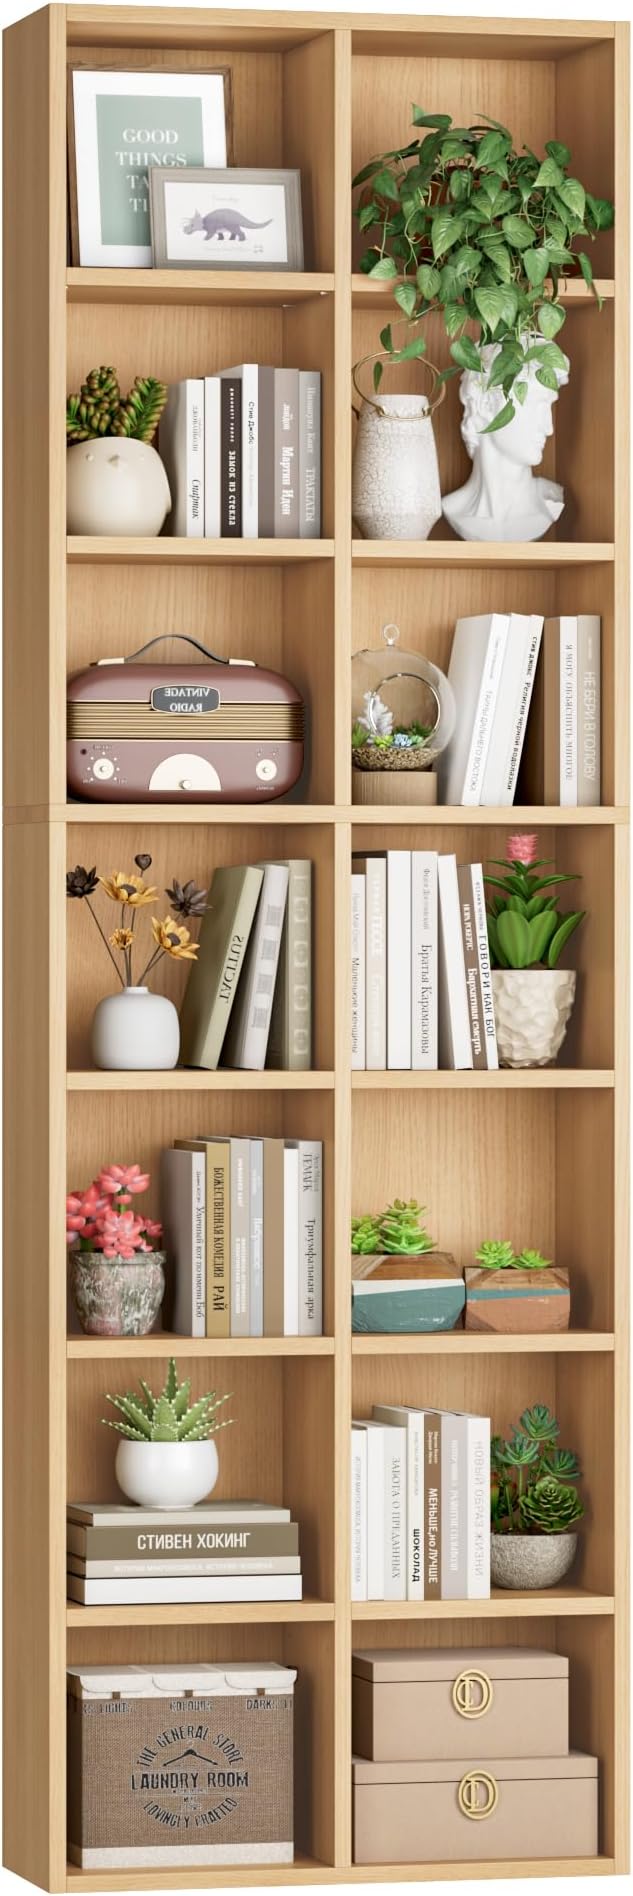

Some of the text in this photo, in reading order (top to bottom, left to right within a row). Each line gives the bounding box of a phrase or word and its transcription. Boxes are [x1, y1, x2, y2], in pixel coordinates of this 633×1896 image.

[122, 128, 179, 144] GOOD
[115, 151, 188, 167] THINGS
[188, 479, 202, 520] Спартак
[280, 446, 296, 515] Мартин Иден
[305, 468, 316, 522] ТРАКТАТЫ
[519, 681, 531, 716] Религия
[583, 671, 596, 782] НЕ БЕРИ В ГОЛОВУ
[506, 747, 519, 791] водолазки
[417, 944, 433, 984] Братья
[478, 934, 491, 989] ГОВОРИ
[418, 985, 433, 1055] Карамазовы
[466, 967, 483, 1055] Бархатная смерть
[483, 993, 493, 1015] КАК
[485, 1018, 495, 1038] БОГ
[194, 1206, 205, 1244] Уличный
[213, 1167, 225, 1278] БОЖЕСТВЕННАЯ КОМЕДИЯ
[304, 1217, 318, 1320] Триумфальная арка
[196, 1301, 205, 1318] Боб
[212, 1285, 228, 1312] РАЙ
[391, 1456, 401, 1497] ЗАБОТА
[391, 1500, 401, 1509] О
[474, 1441, 486, 1577] НОВЫЙ ОБРАЗ ЖИЗНИ
[137, 1532, 252, 1550] СТИВЕН ХОКИНГ
[411, 1528, 421, 1583] ШОКОЛАД
[428, 1548, 438, 1585] ЛУЧШЕ
[136, 1725, 244, 1767] THE GENERAL STORE
[131, 1771, 249, 1790] LAUNDRY ROOM
[143, 1797, 239, 1828] LOVINGLY CRAFTED
